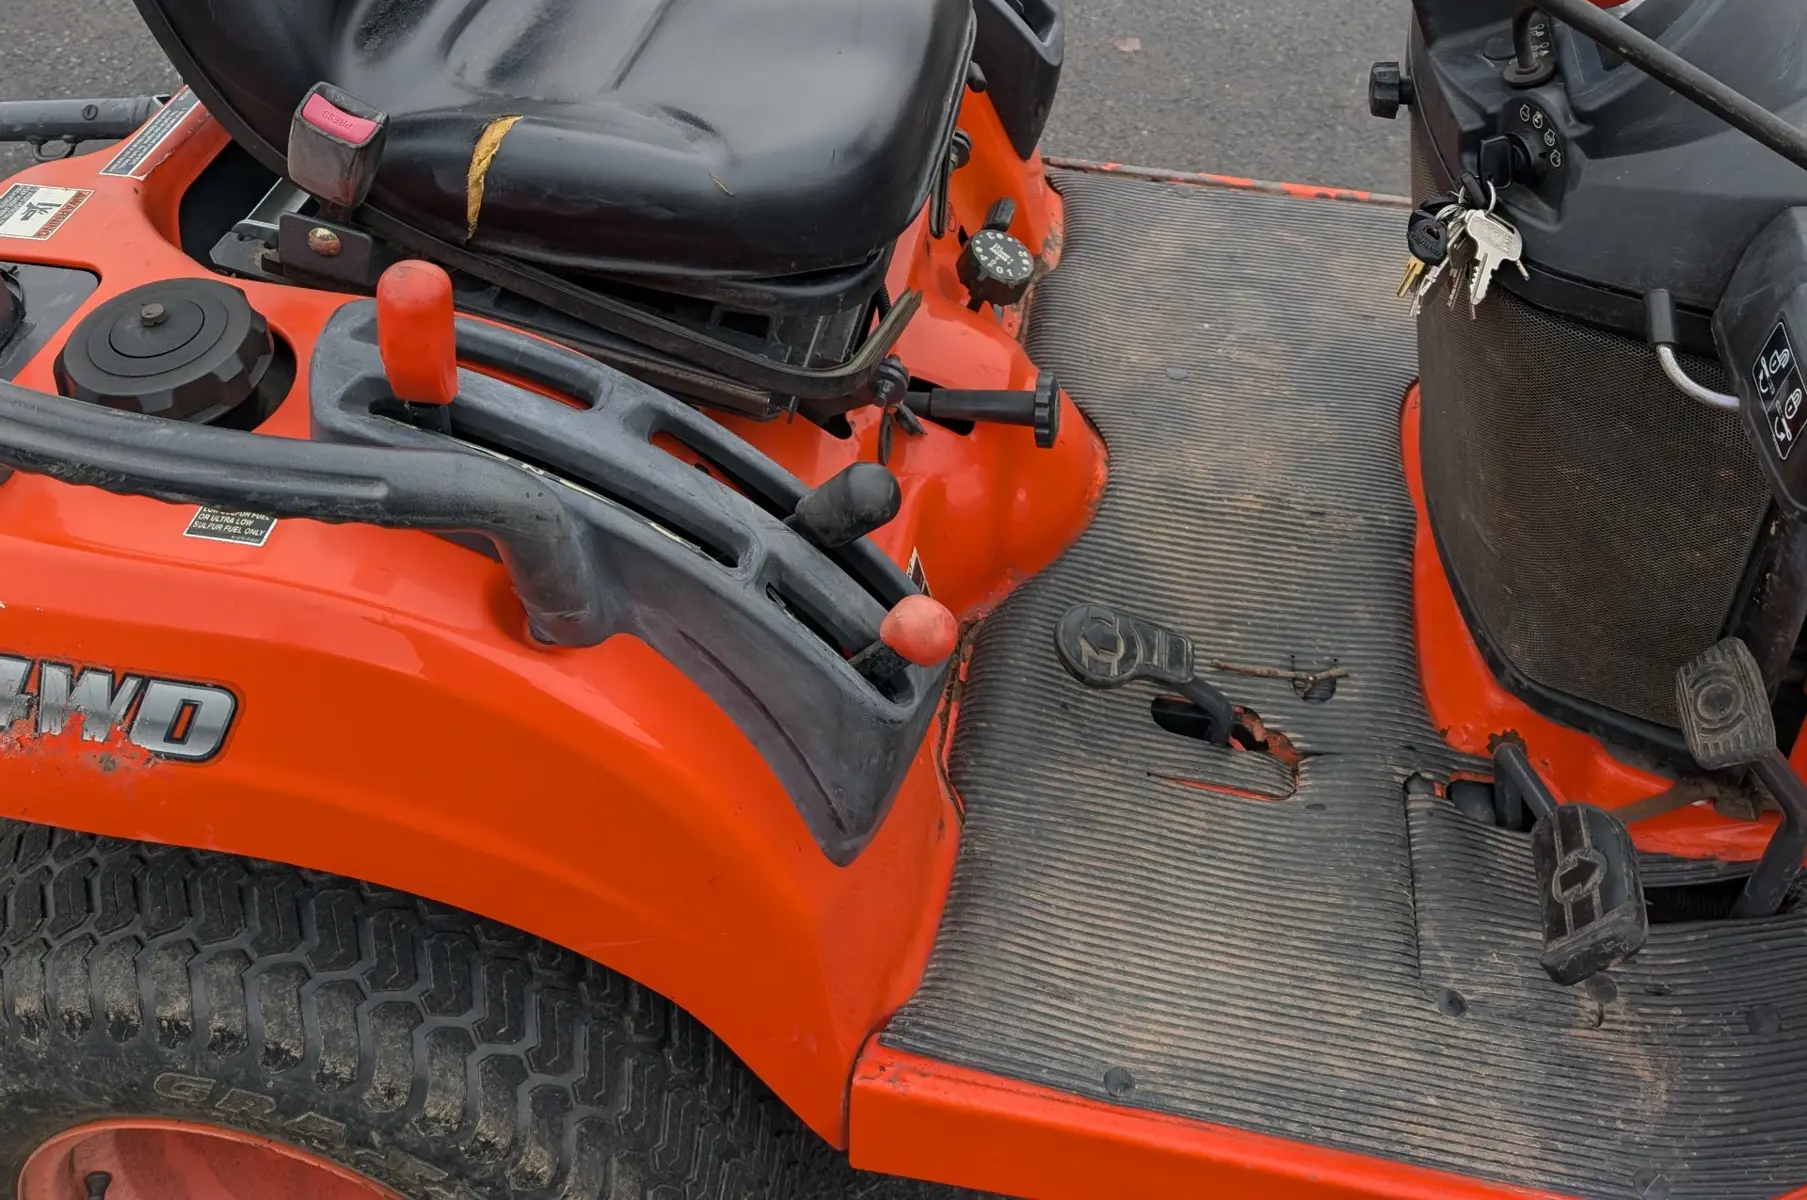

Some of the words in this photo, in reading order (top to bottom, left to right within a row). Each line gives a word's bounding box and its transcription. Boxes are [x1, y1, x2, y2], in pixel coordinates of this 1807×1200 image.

[321, 110, 354, 130] PRESS
[37, 192, 87, 238] WARNING
[193, 521, 223, 530] SULFUR
[223, 525, 242, 534] FUEL
[244, 527, 266, 537] ONLY
[210, 515, 234, 524] ULTRA
[235, 517, 255, 526] LOW
